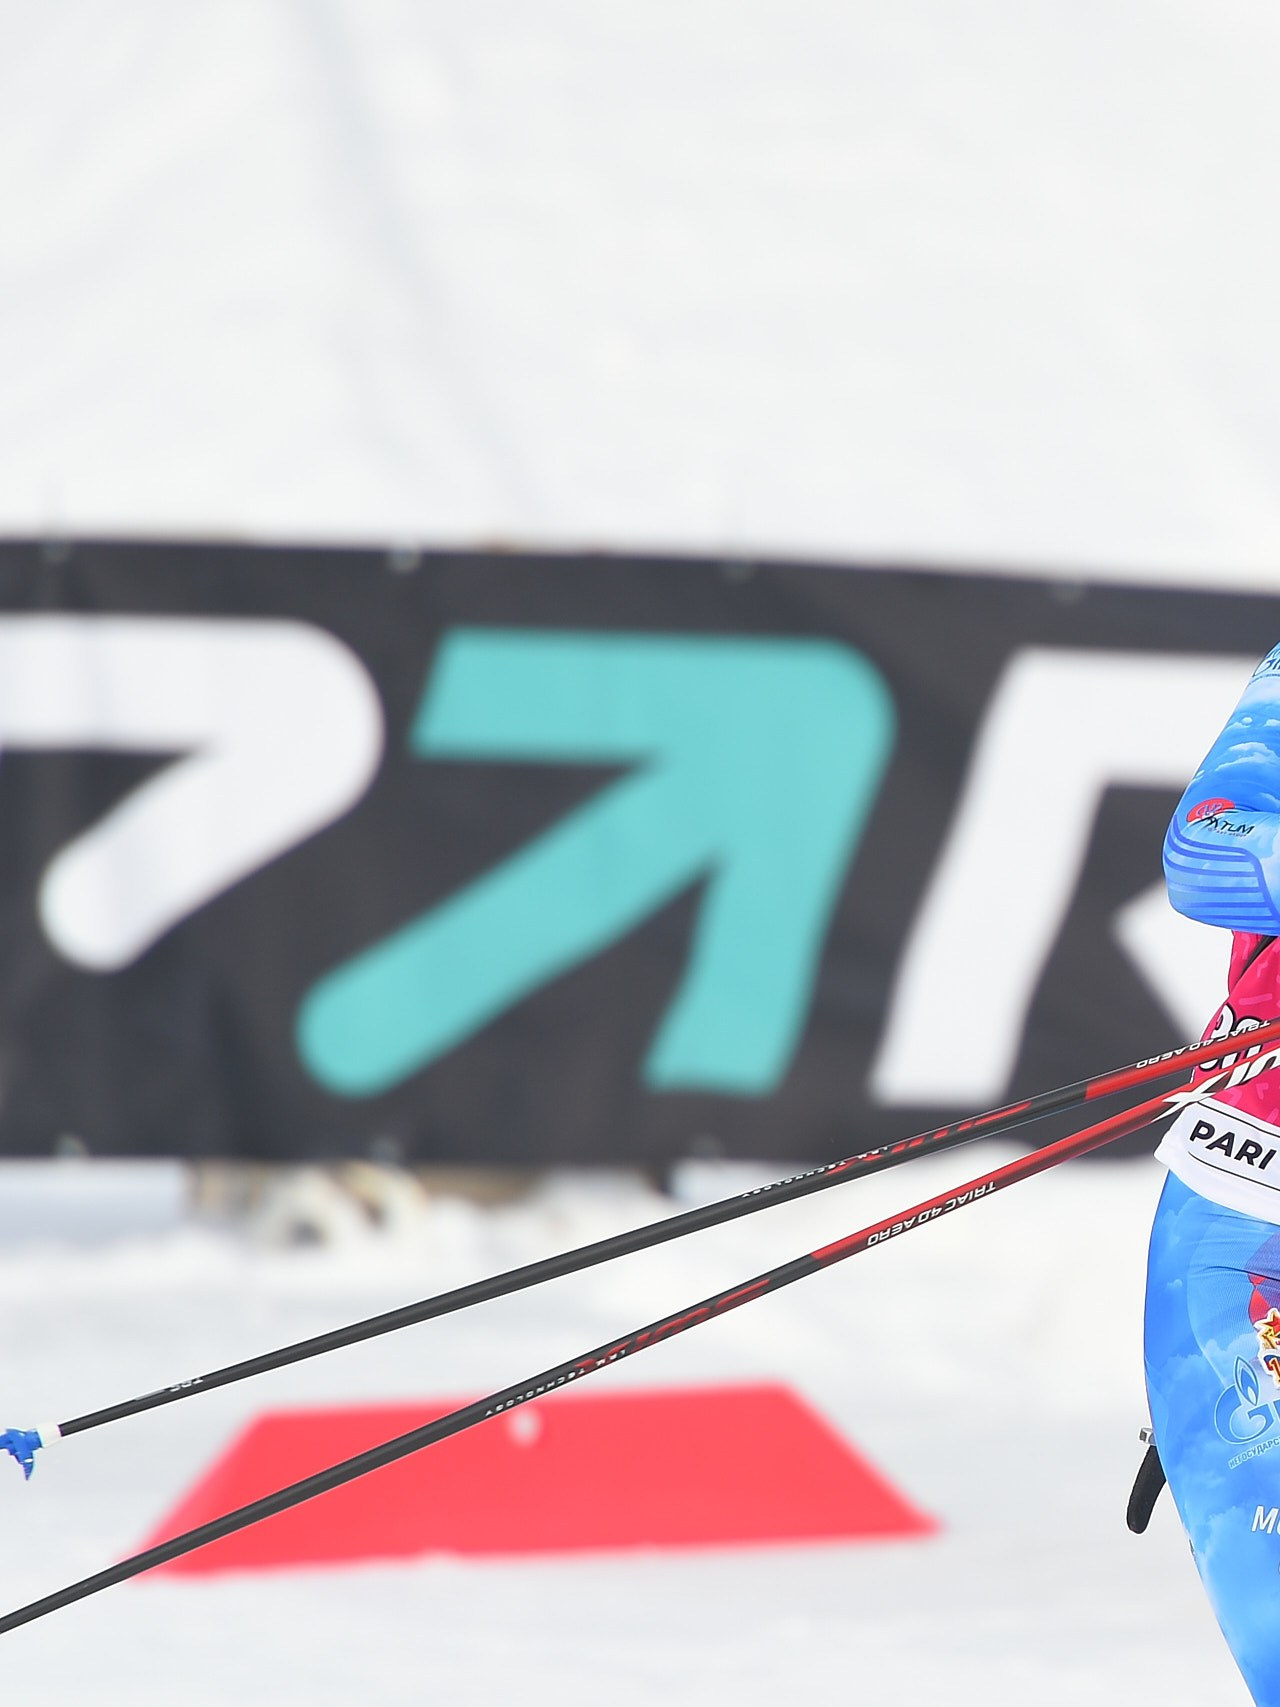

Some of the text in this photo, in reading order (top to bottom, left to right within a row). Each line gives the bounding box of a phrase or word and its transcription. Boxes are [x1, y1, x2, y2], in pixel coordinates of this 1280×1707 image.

[1135, 1045, 1190, 1069] AERO
[1189, 1119, 1277, 1171] PARI
[944, 1181, 997, 1212] TRIAC
[866, 1216, 917, 1246] AERO
